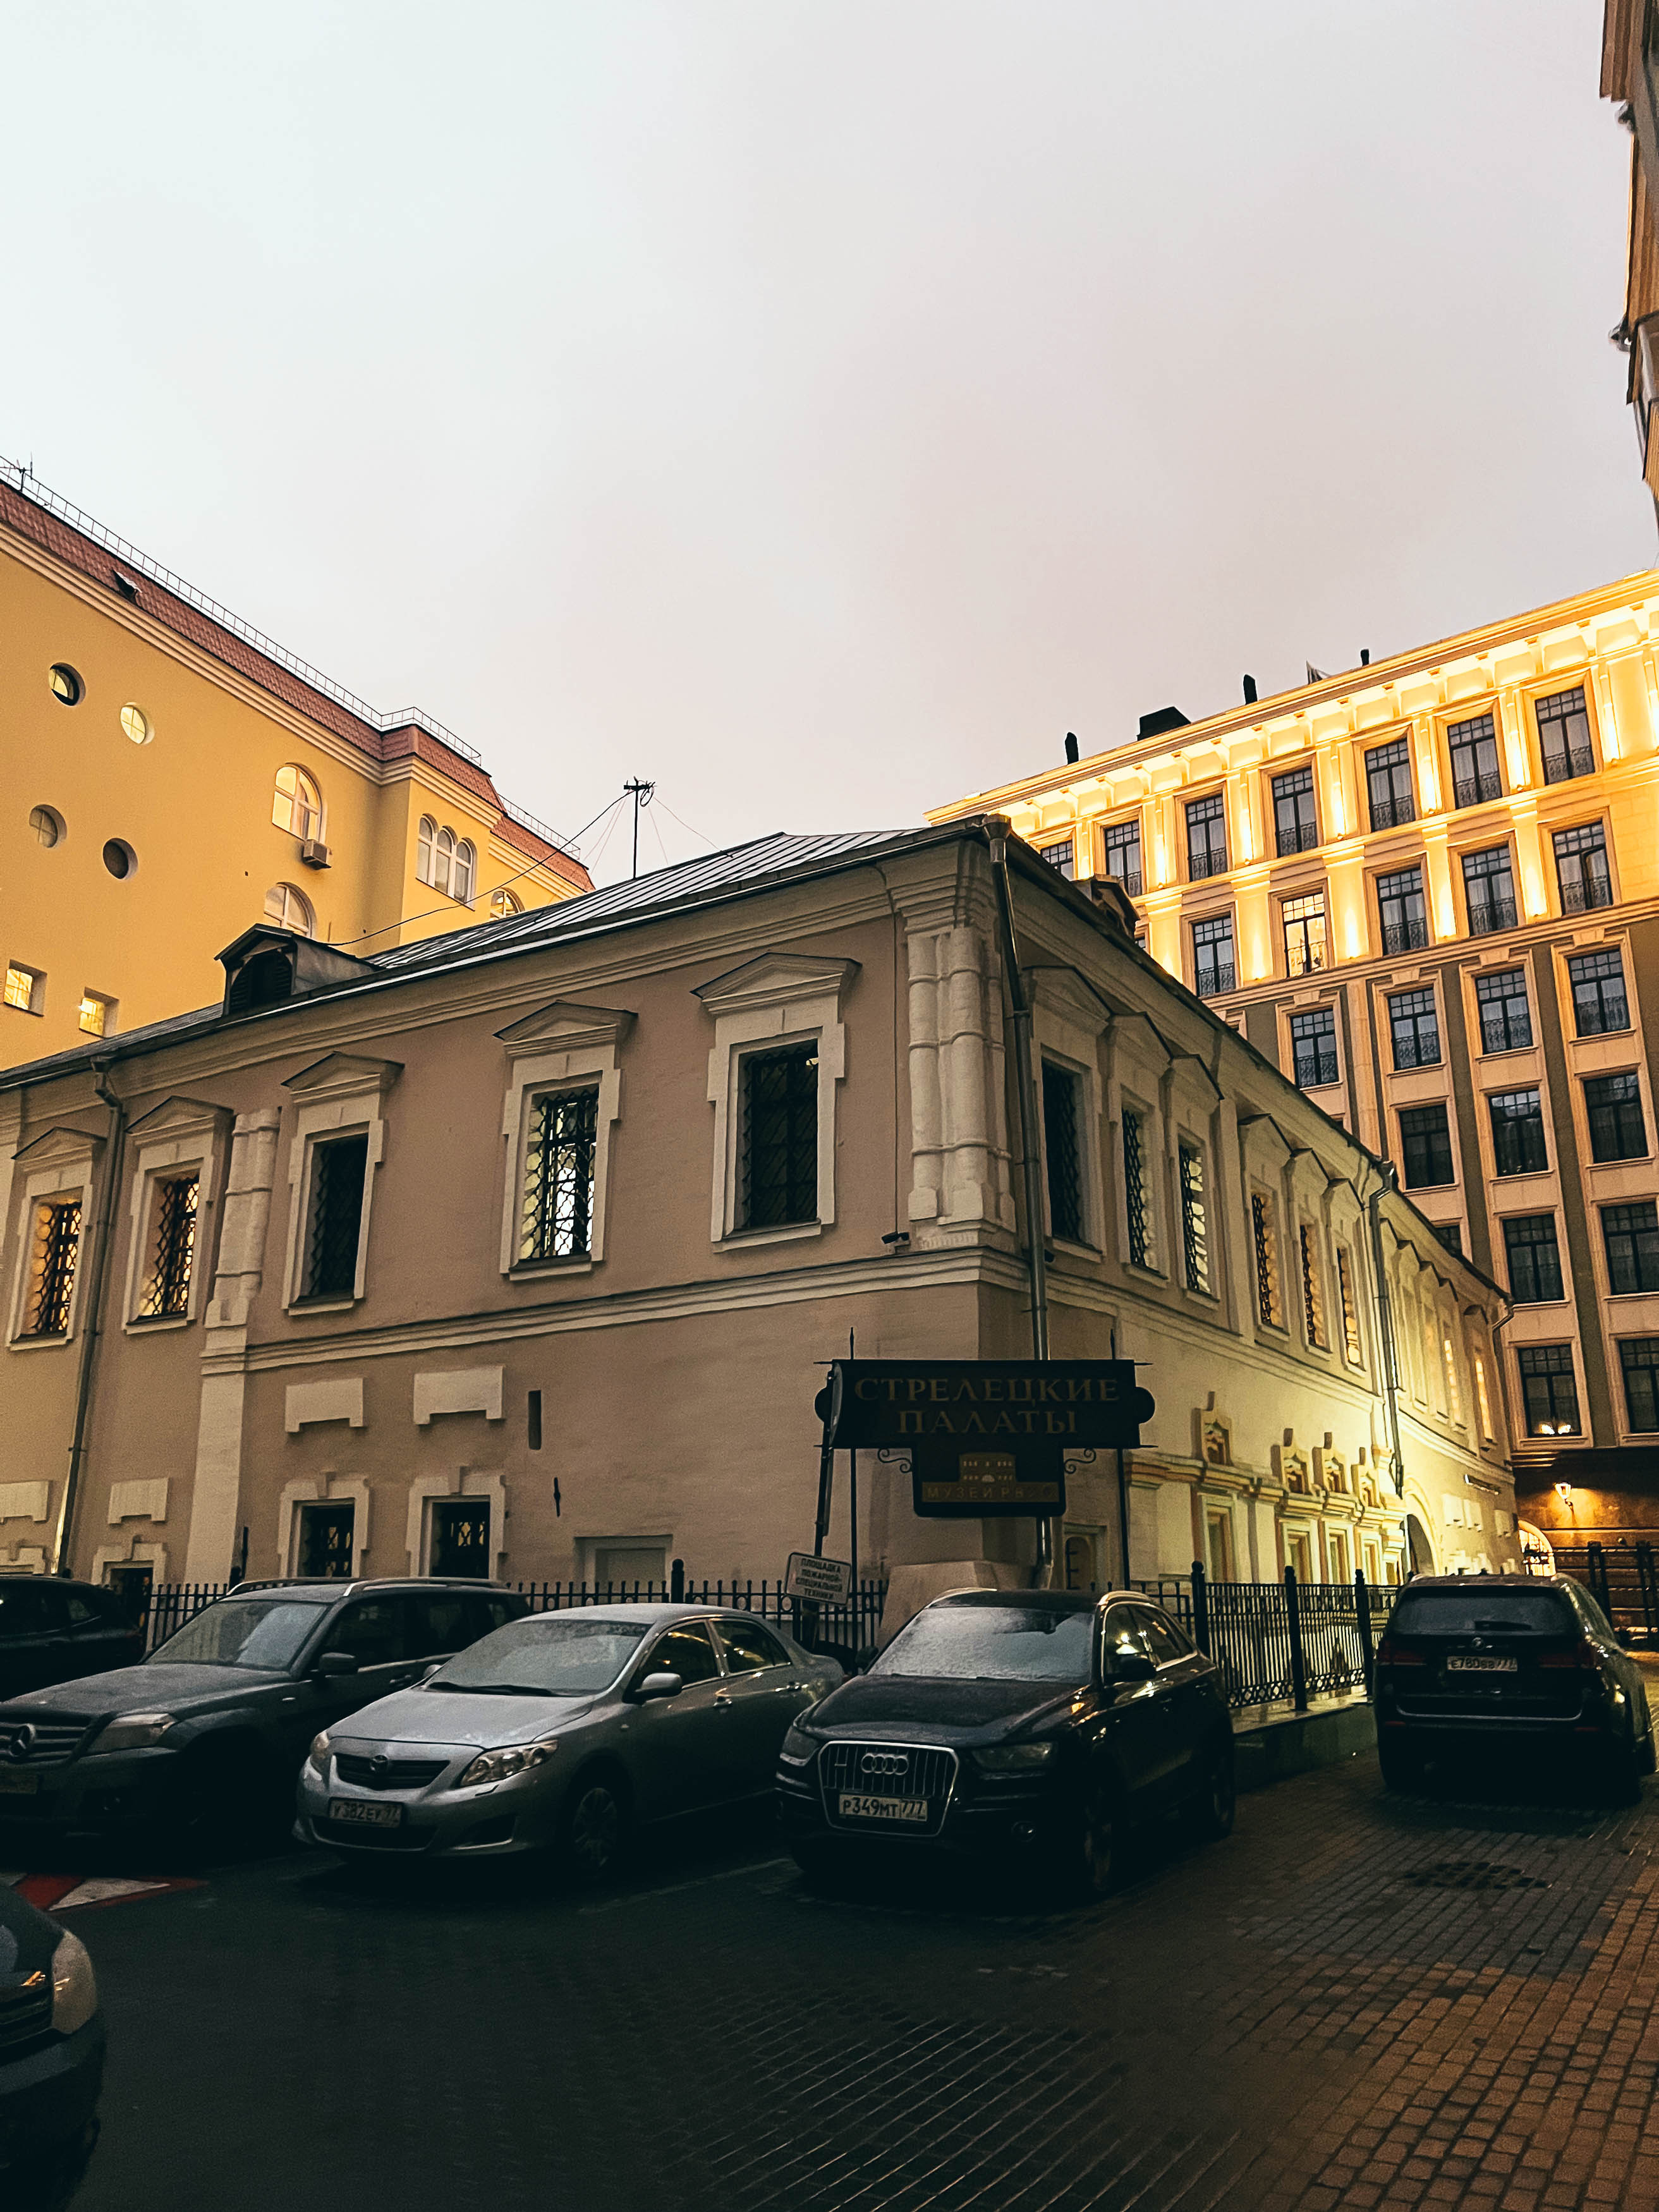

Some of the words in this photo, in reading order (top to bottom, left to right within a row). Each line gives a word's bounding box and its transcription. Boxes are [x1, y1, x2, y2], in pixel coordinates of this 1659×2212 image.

[854, 1377, 1121, 1407] СТРЕЛЕЦКИЕ
[896, 1410, 1078, 1434] ПАЛАТЫ
[927, 1485, 993, 1498] МУЗЕЙ
